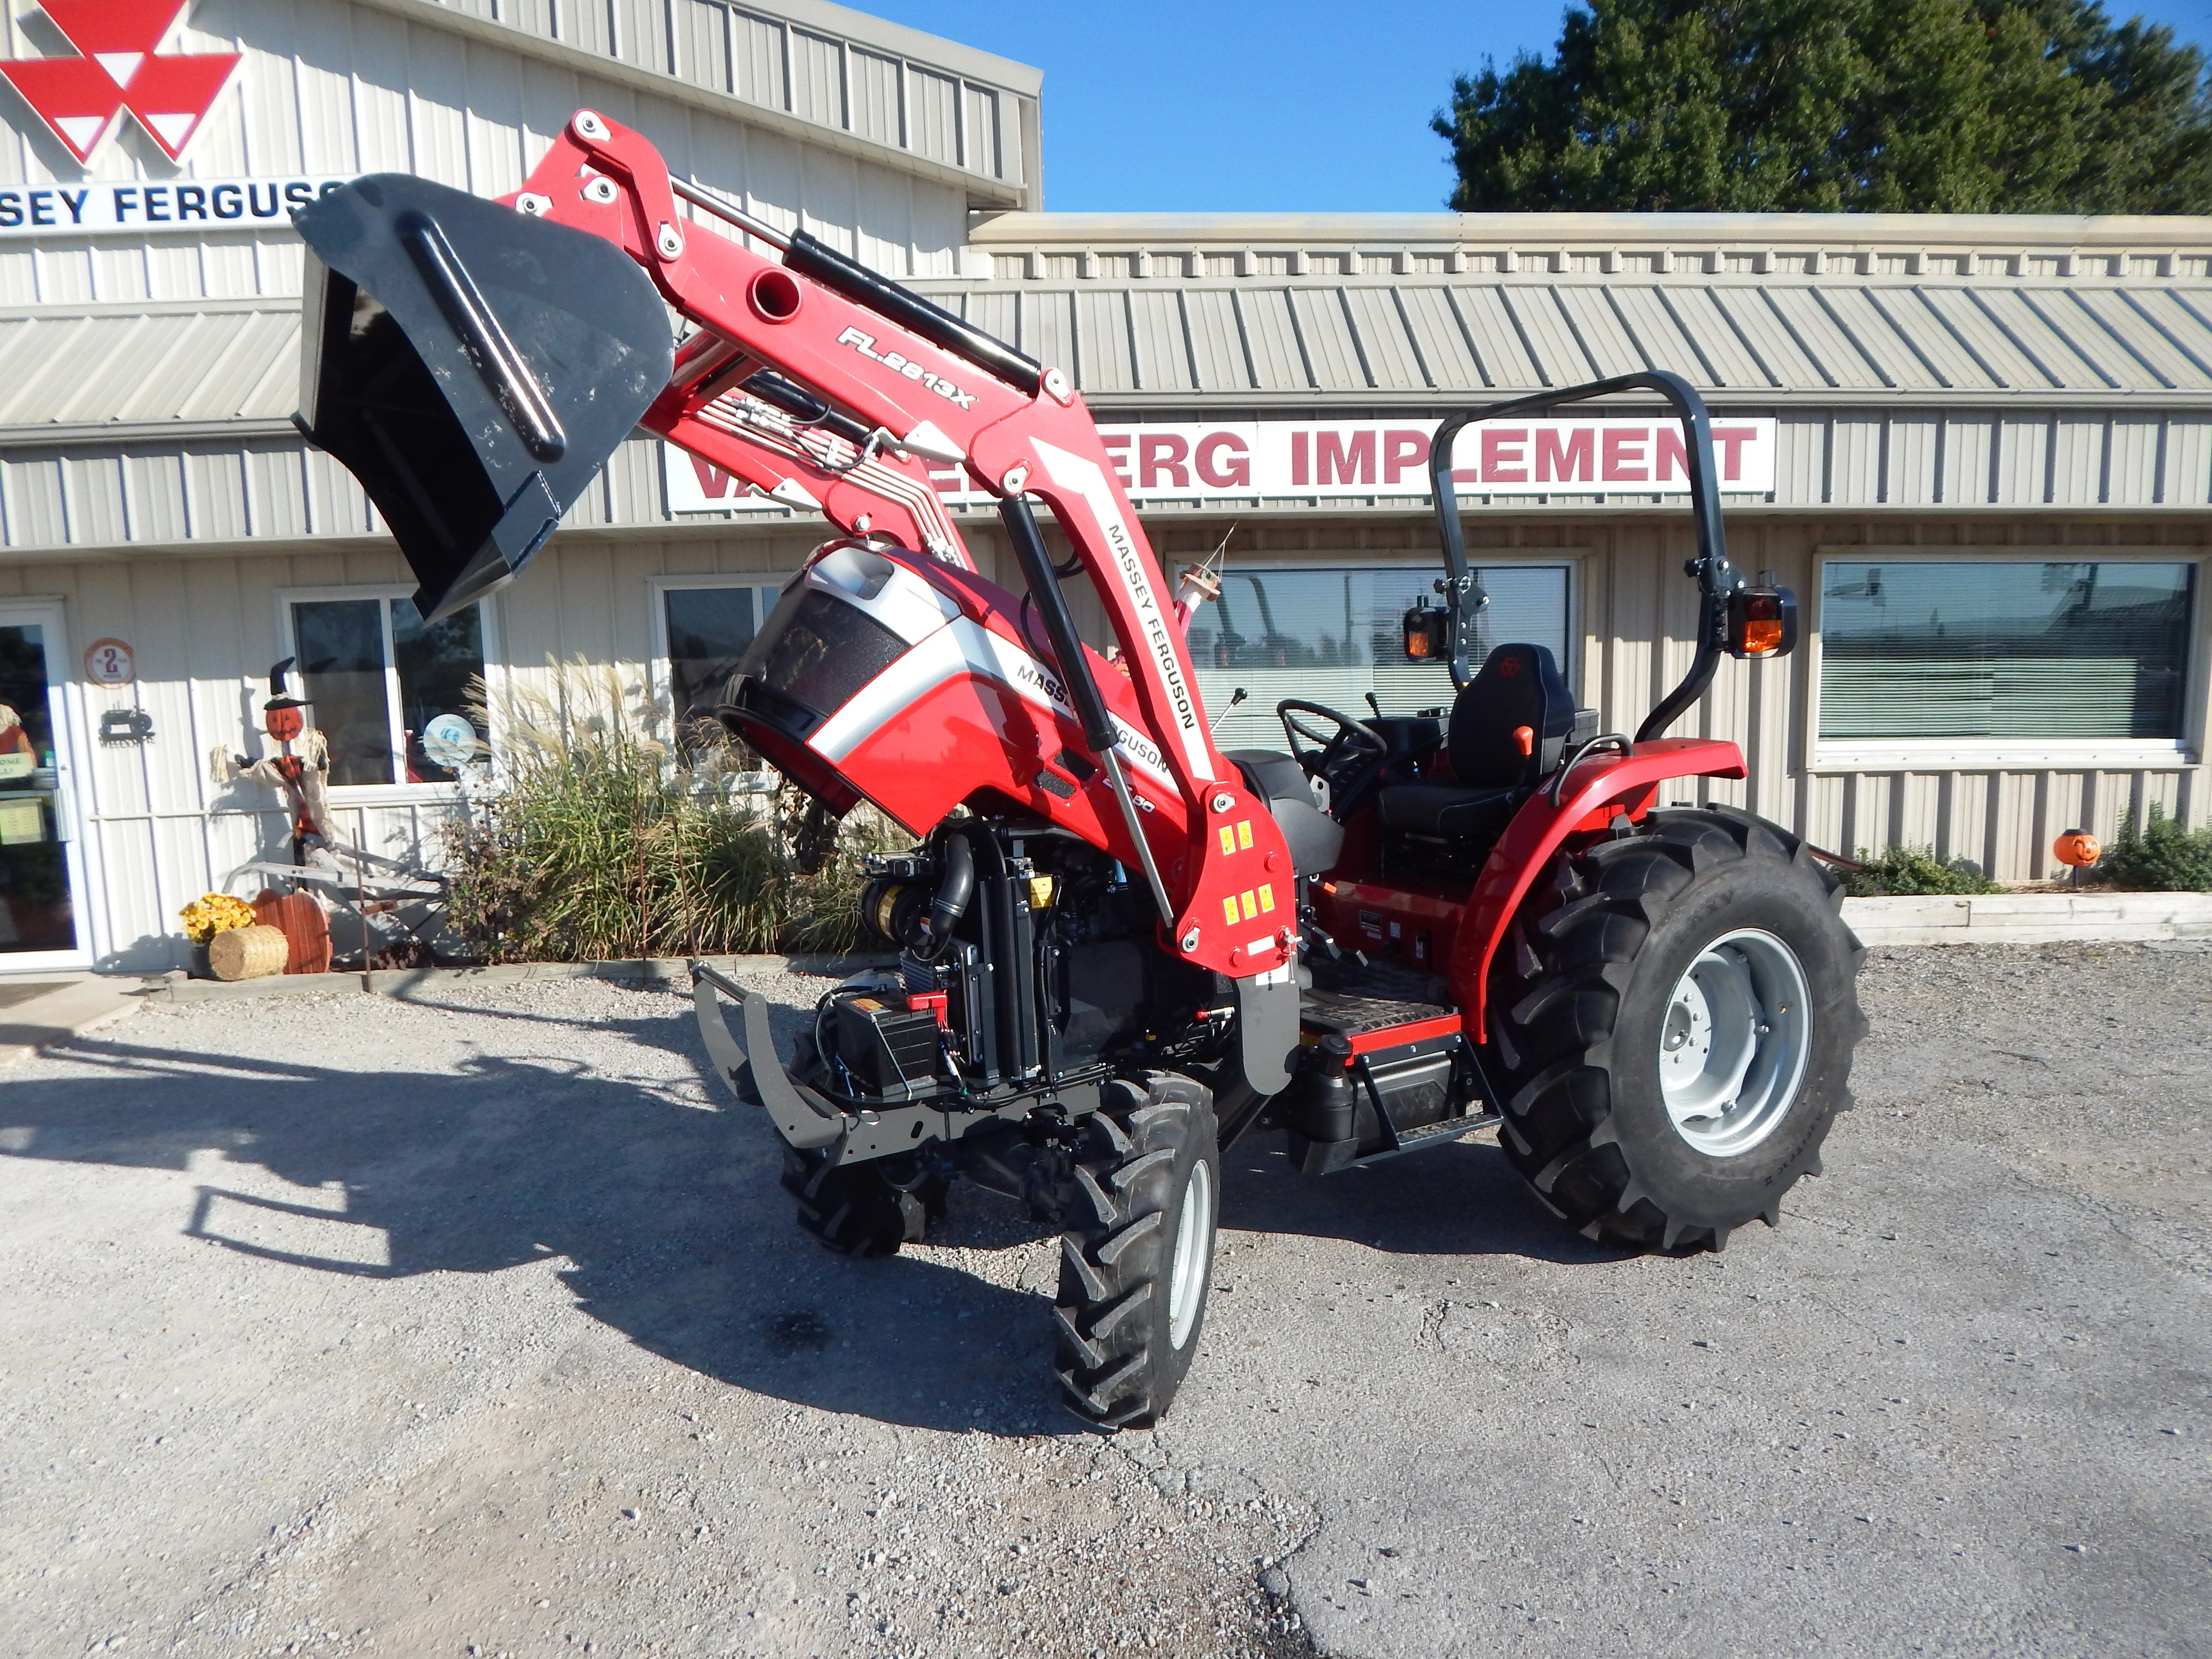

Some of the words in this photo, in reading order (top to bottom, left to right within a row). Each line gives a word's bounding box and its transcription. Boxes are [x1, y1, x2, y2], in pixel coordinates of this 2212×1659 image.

[113, 181, 346, 223] FERGUS
[1291, 428, 1757, 486] IMPEMENT
[1108, 524, 1152, 610] MASSEY
[1148, 619, 1195, 729] FERGUSON
[104, 648, 119, 673] 2
[1017, 665, 1070, 708] MASS
